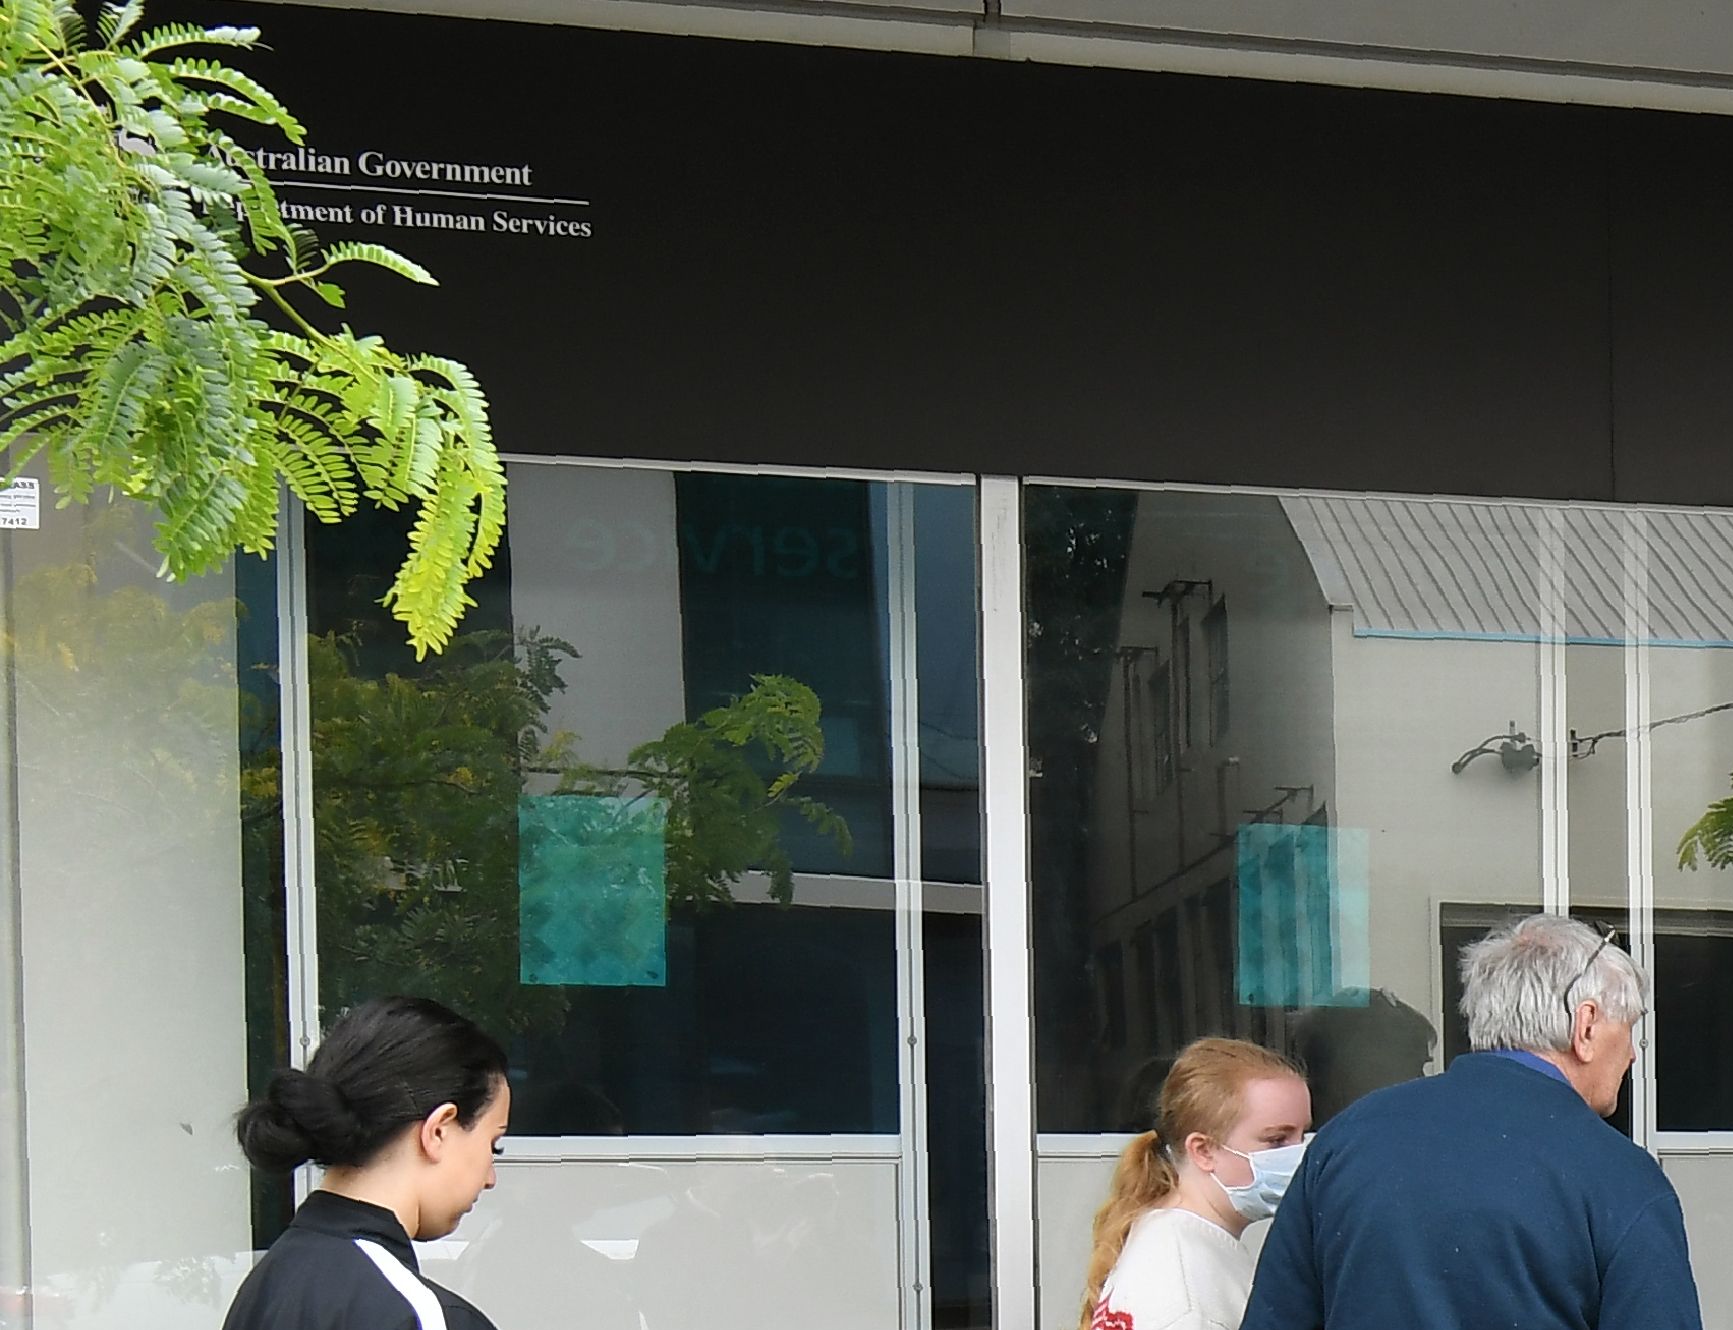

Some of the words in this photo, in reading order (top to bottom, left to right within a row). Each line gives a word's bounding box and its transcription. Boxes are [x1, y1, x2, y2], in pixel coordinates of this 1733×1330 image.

[359, 150, 532, 187] Government
[361, 203, 387, 225] of
[393, 207, 485, 231] Human
[492, 211, 592, 237] Services
